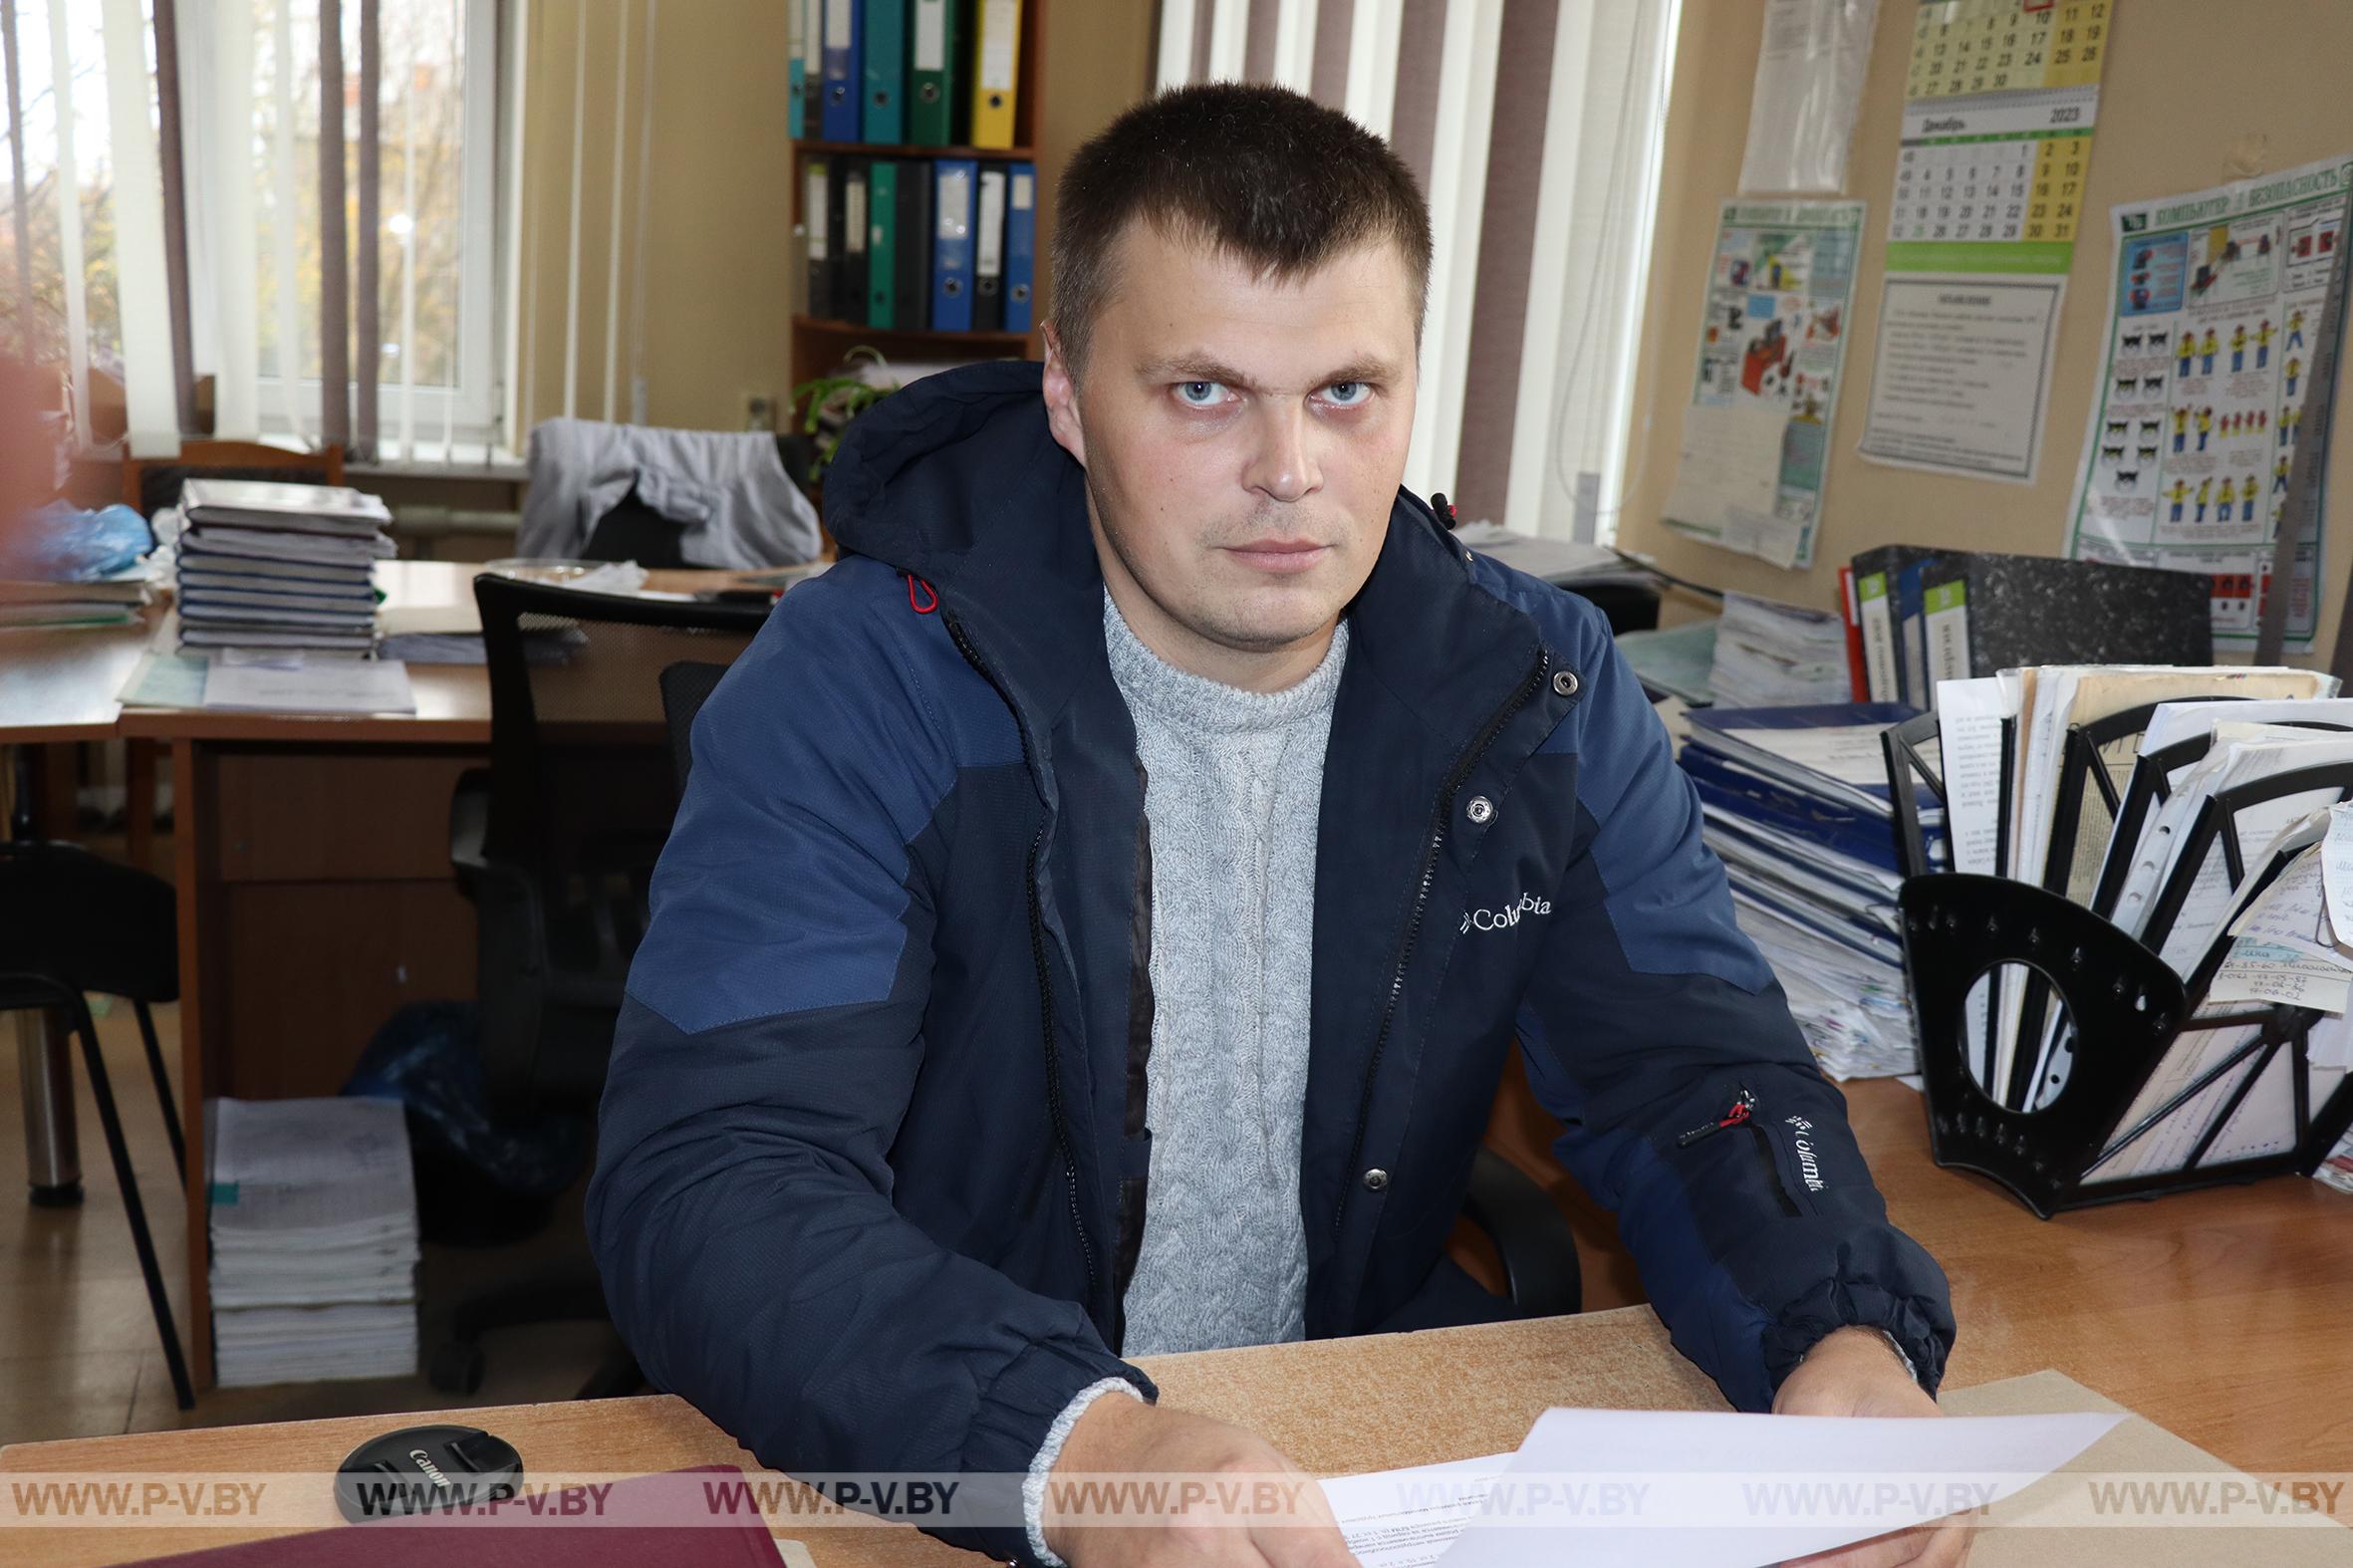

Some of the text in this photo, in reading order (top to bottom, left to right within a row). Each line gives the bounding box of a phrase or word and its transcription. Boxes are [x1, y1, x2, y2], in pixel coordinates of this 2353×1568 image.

[2048, 106, 2080, 124] 2023
[1473, 893, 1552, 931] Colubia
[409, 1449, 451, 1487] Canon
